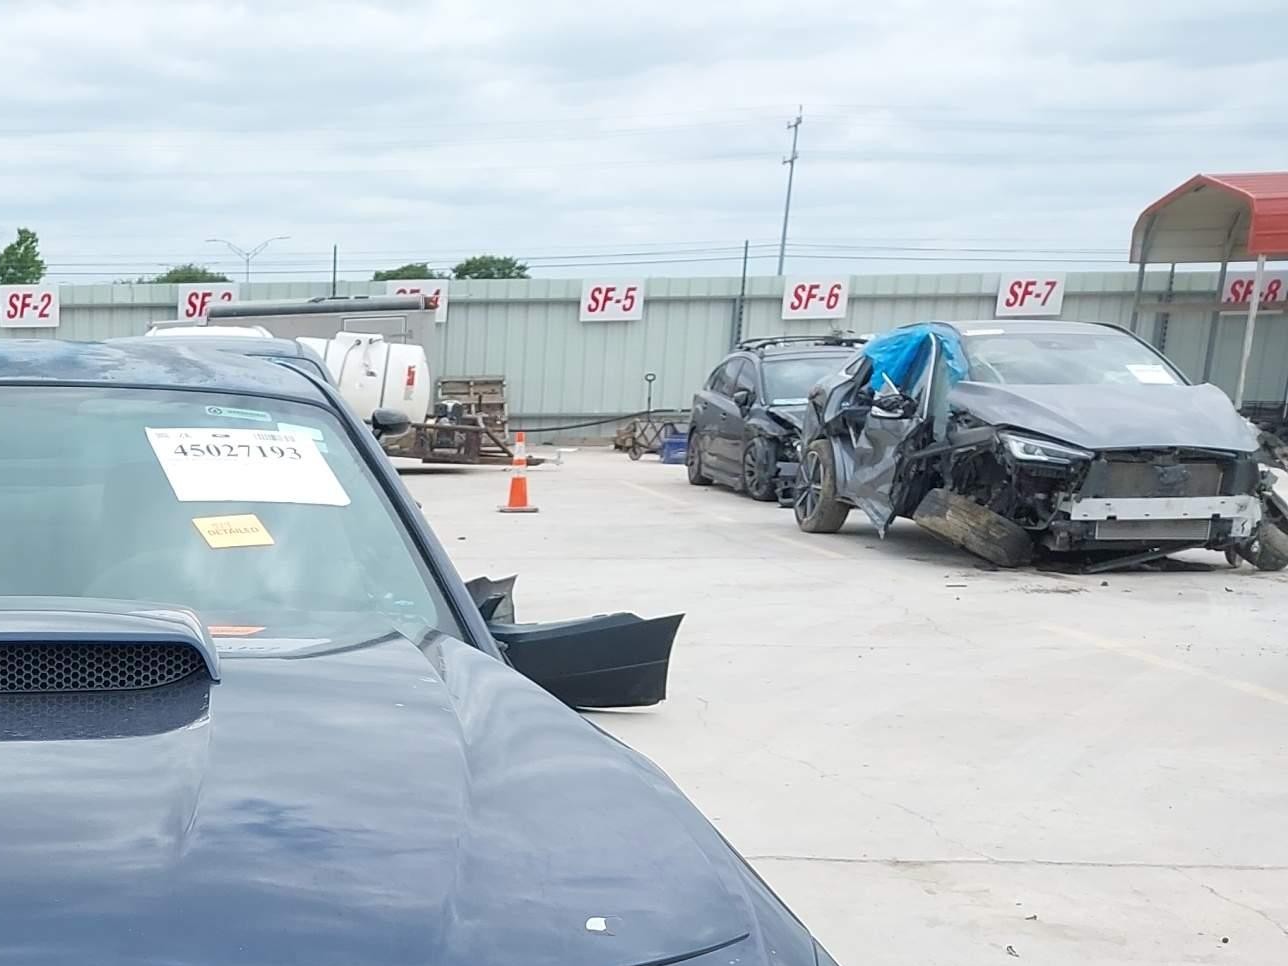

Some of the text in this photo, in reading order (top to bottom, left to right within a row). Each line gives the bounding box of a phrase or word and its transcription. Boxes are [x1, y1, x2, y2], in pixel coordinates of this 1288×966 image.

[7, 293, 52, 319] SF-2
[587, 287, 637, 313] SF-5
[790, 284, 842, 311] SF-6
[1005, 281, 1057, 307] SF-7
[173, 443, 302, 460] 45027193
